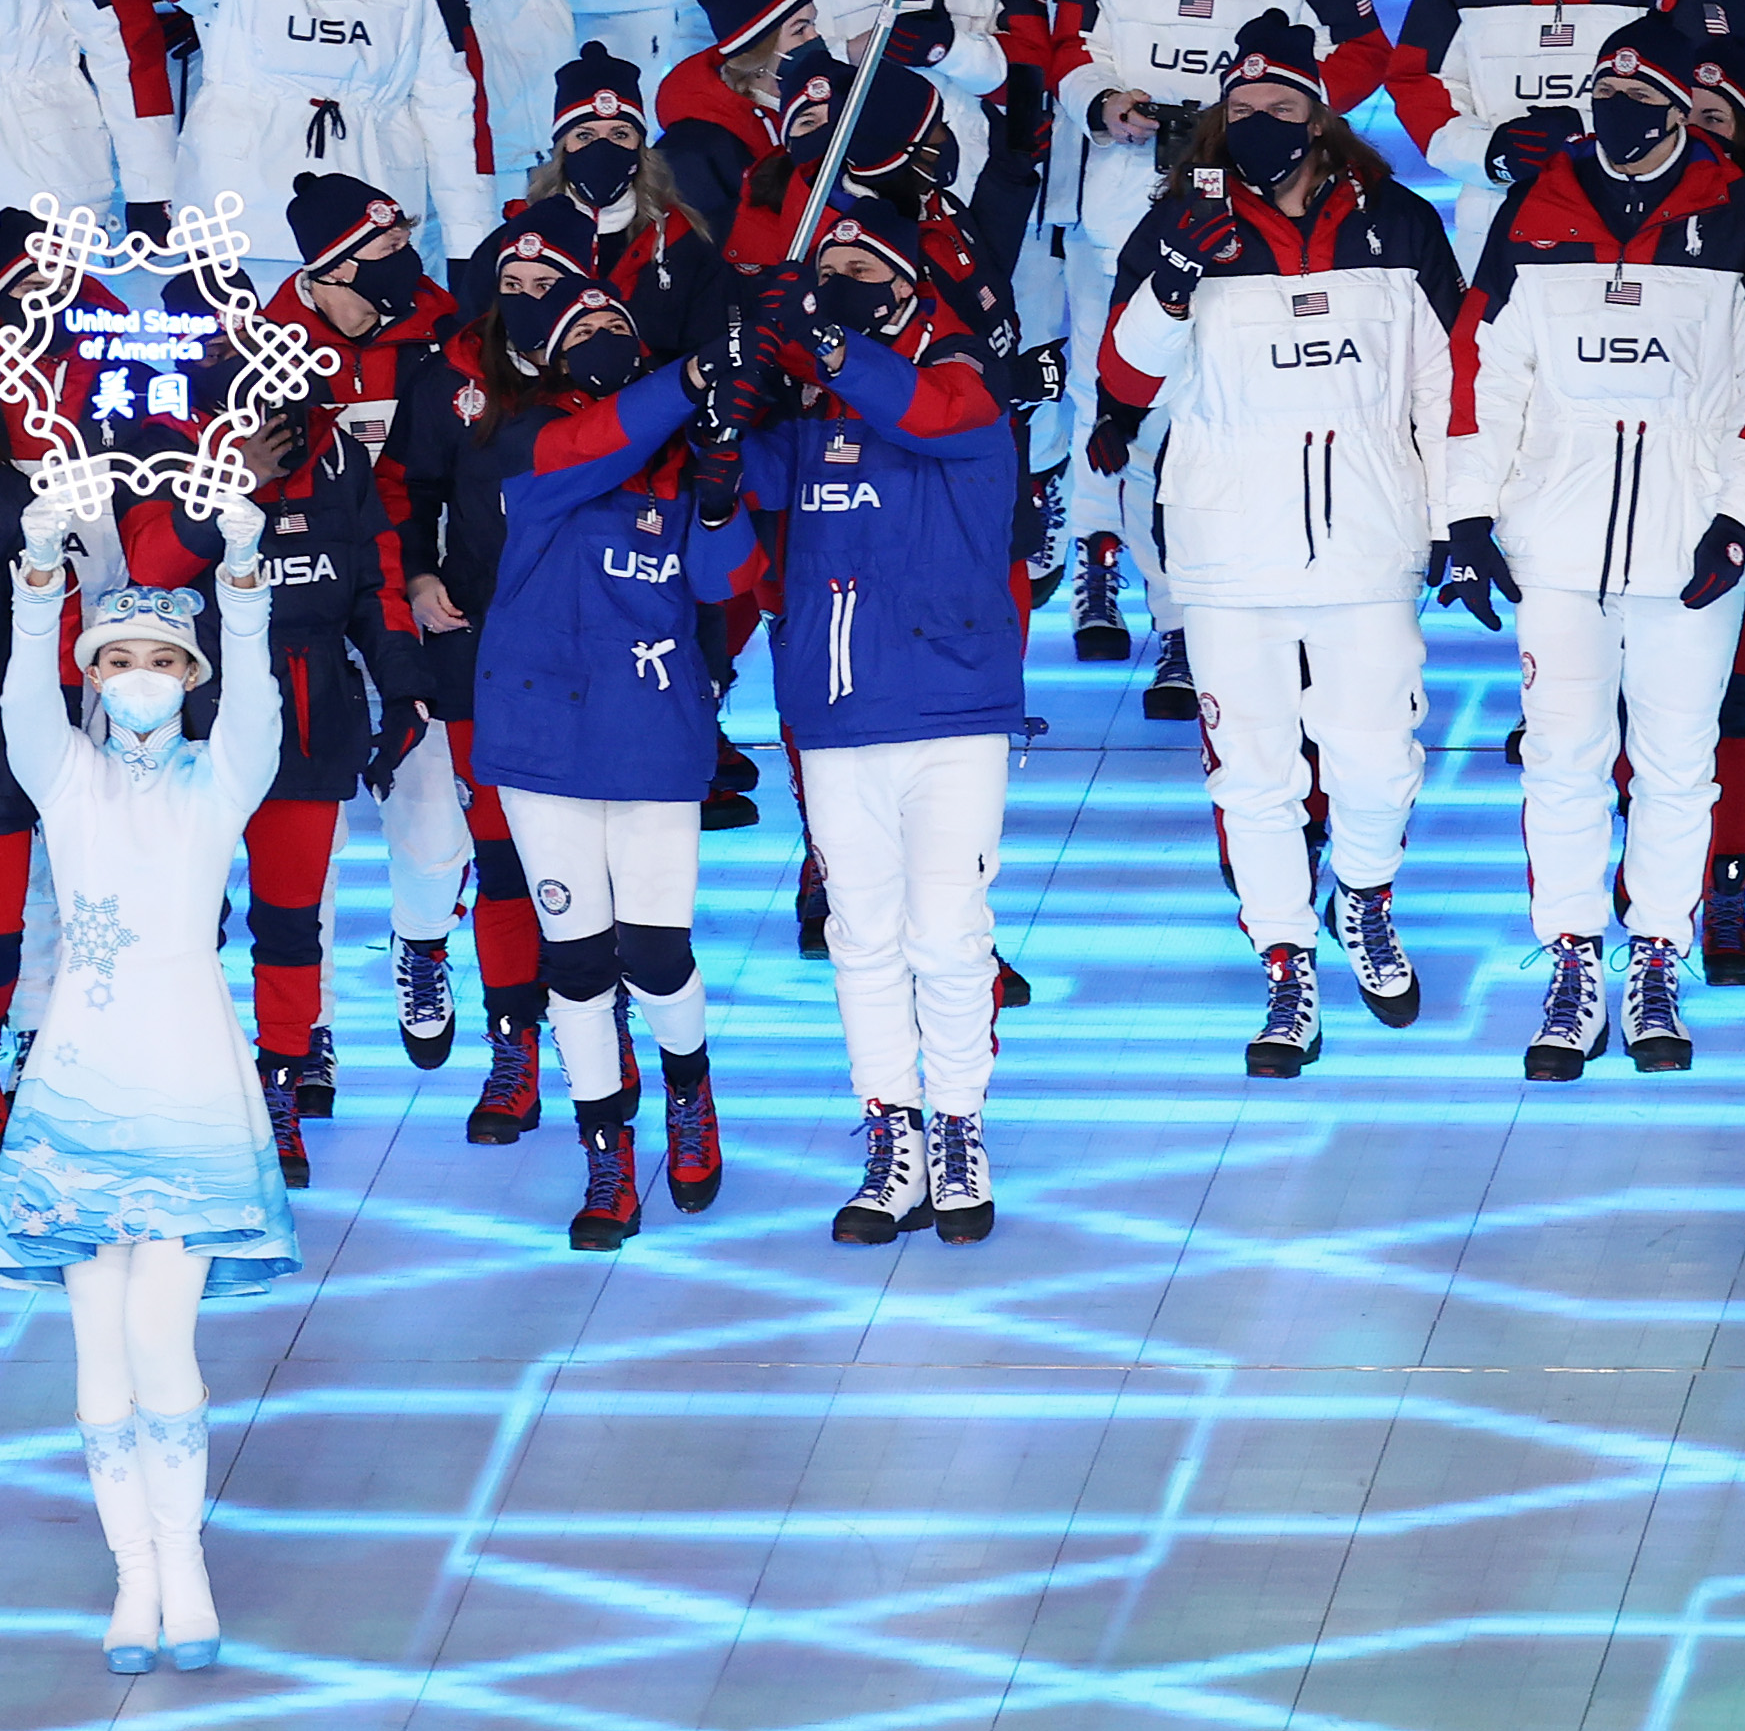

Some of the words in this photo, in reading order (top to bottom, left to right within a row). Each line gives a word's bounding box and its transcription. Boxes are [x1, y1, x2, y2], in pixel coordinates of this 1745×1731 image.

[287, 16, 372, 46] USA
[1152, 44, 1234, 73] USA
[1515, 74, 1594, 100] USA
[1493, 155, 1512, 182] SA
[1158, 238, 1203, 278] USA
[65, 308, 140, 333] United
[143, 309, 218, 334] States
[79, 336, 105, 360] of
[107, 337, 204, 360] America
[1272, 341, 1361, 369] USA
[1578, 337, 1670, 364] USA
[1042, 347, 1062, 400] USA
[91, 366, 189, 421] 美国
[800, 483, 881, 511] USA
[605, 547, 681, 582] USA
[1450, 565, 1478, 583] SA
